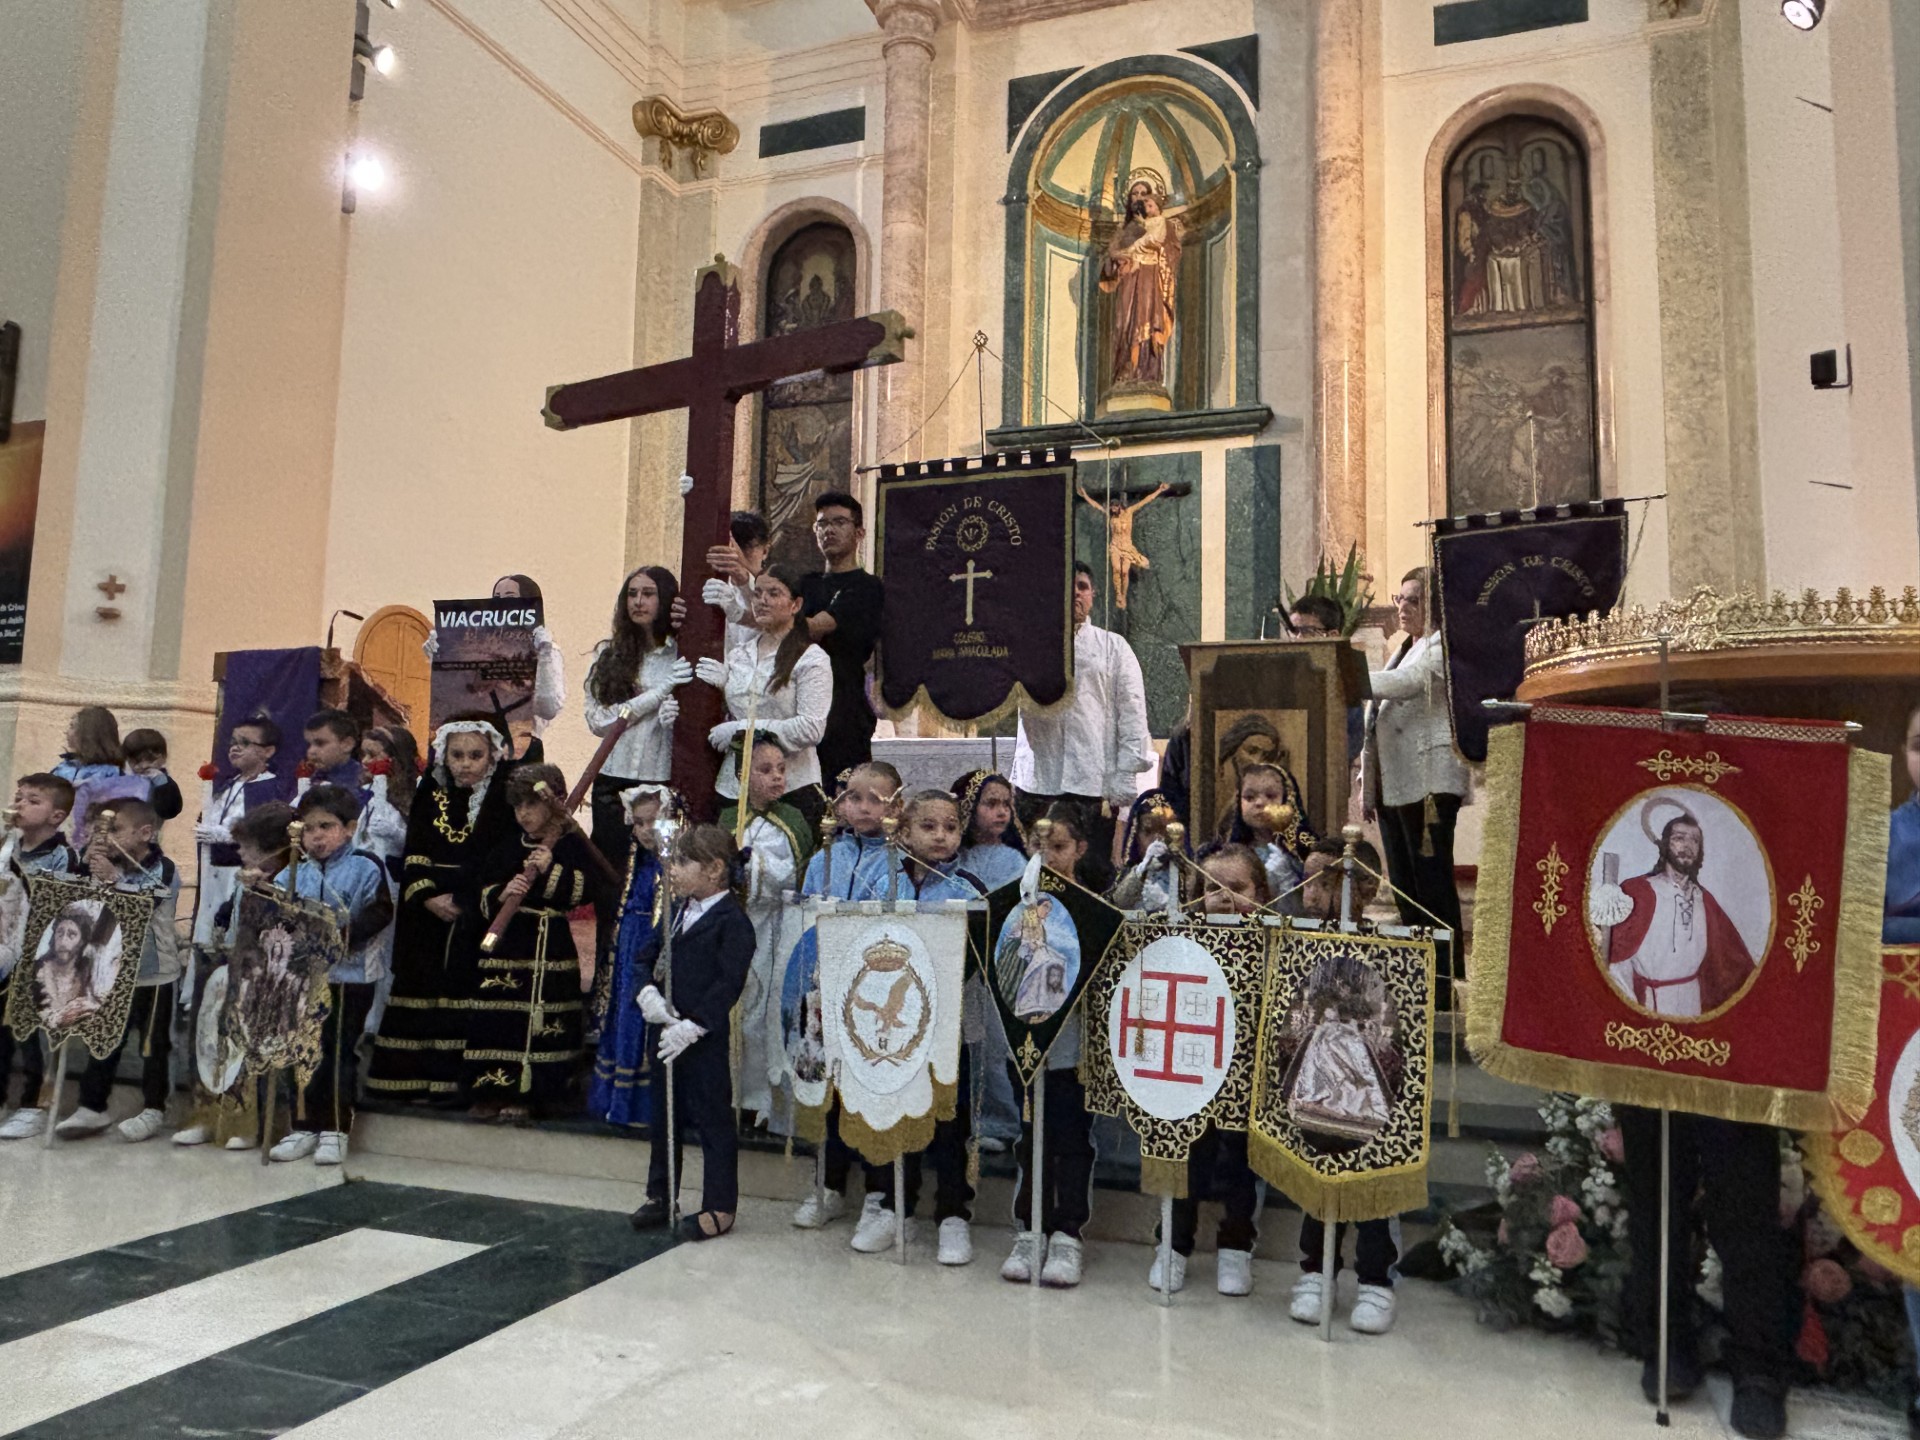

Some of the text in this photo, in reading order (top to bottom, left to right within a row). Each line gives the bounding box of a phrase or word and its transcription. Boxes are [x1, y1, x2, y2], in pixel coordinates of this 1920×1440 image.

[963, 496, 983, 510] DE
[987, 500, 1022, 546] CRISTO
[439, 608, 536, 628] VIACRUCIS
